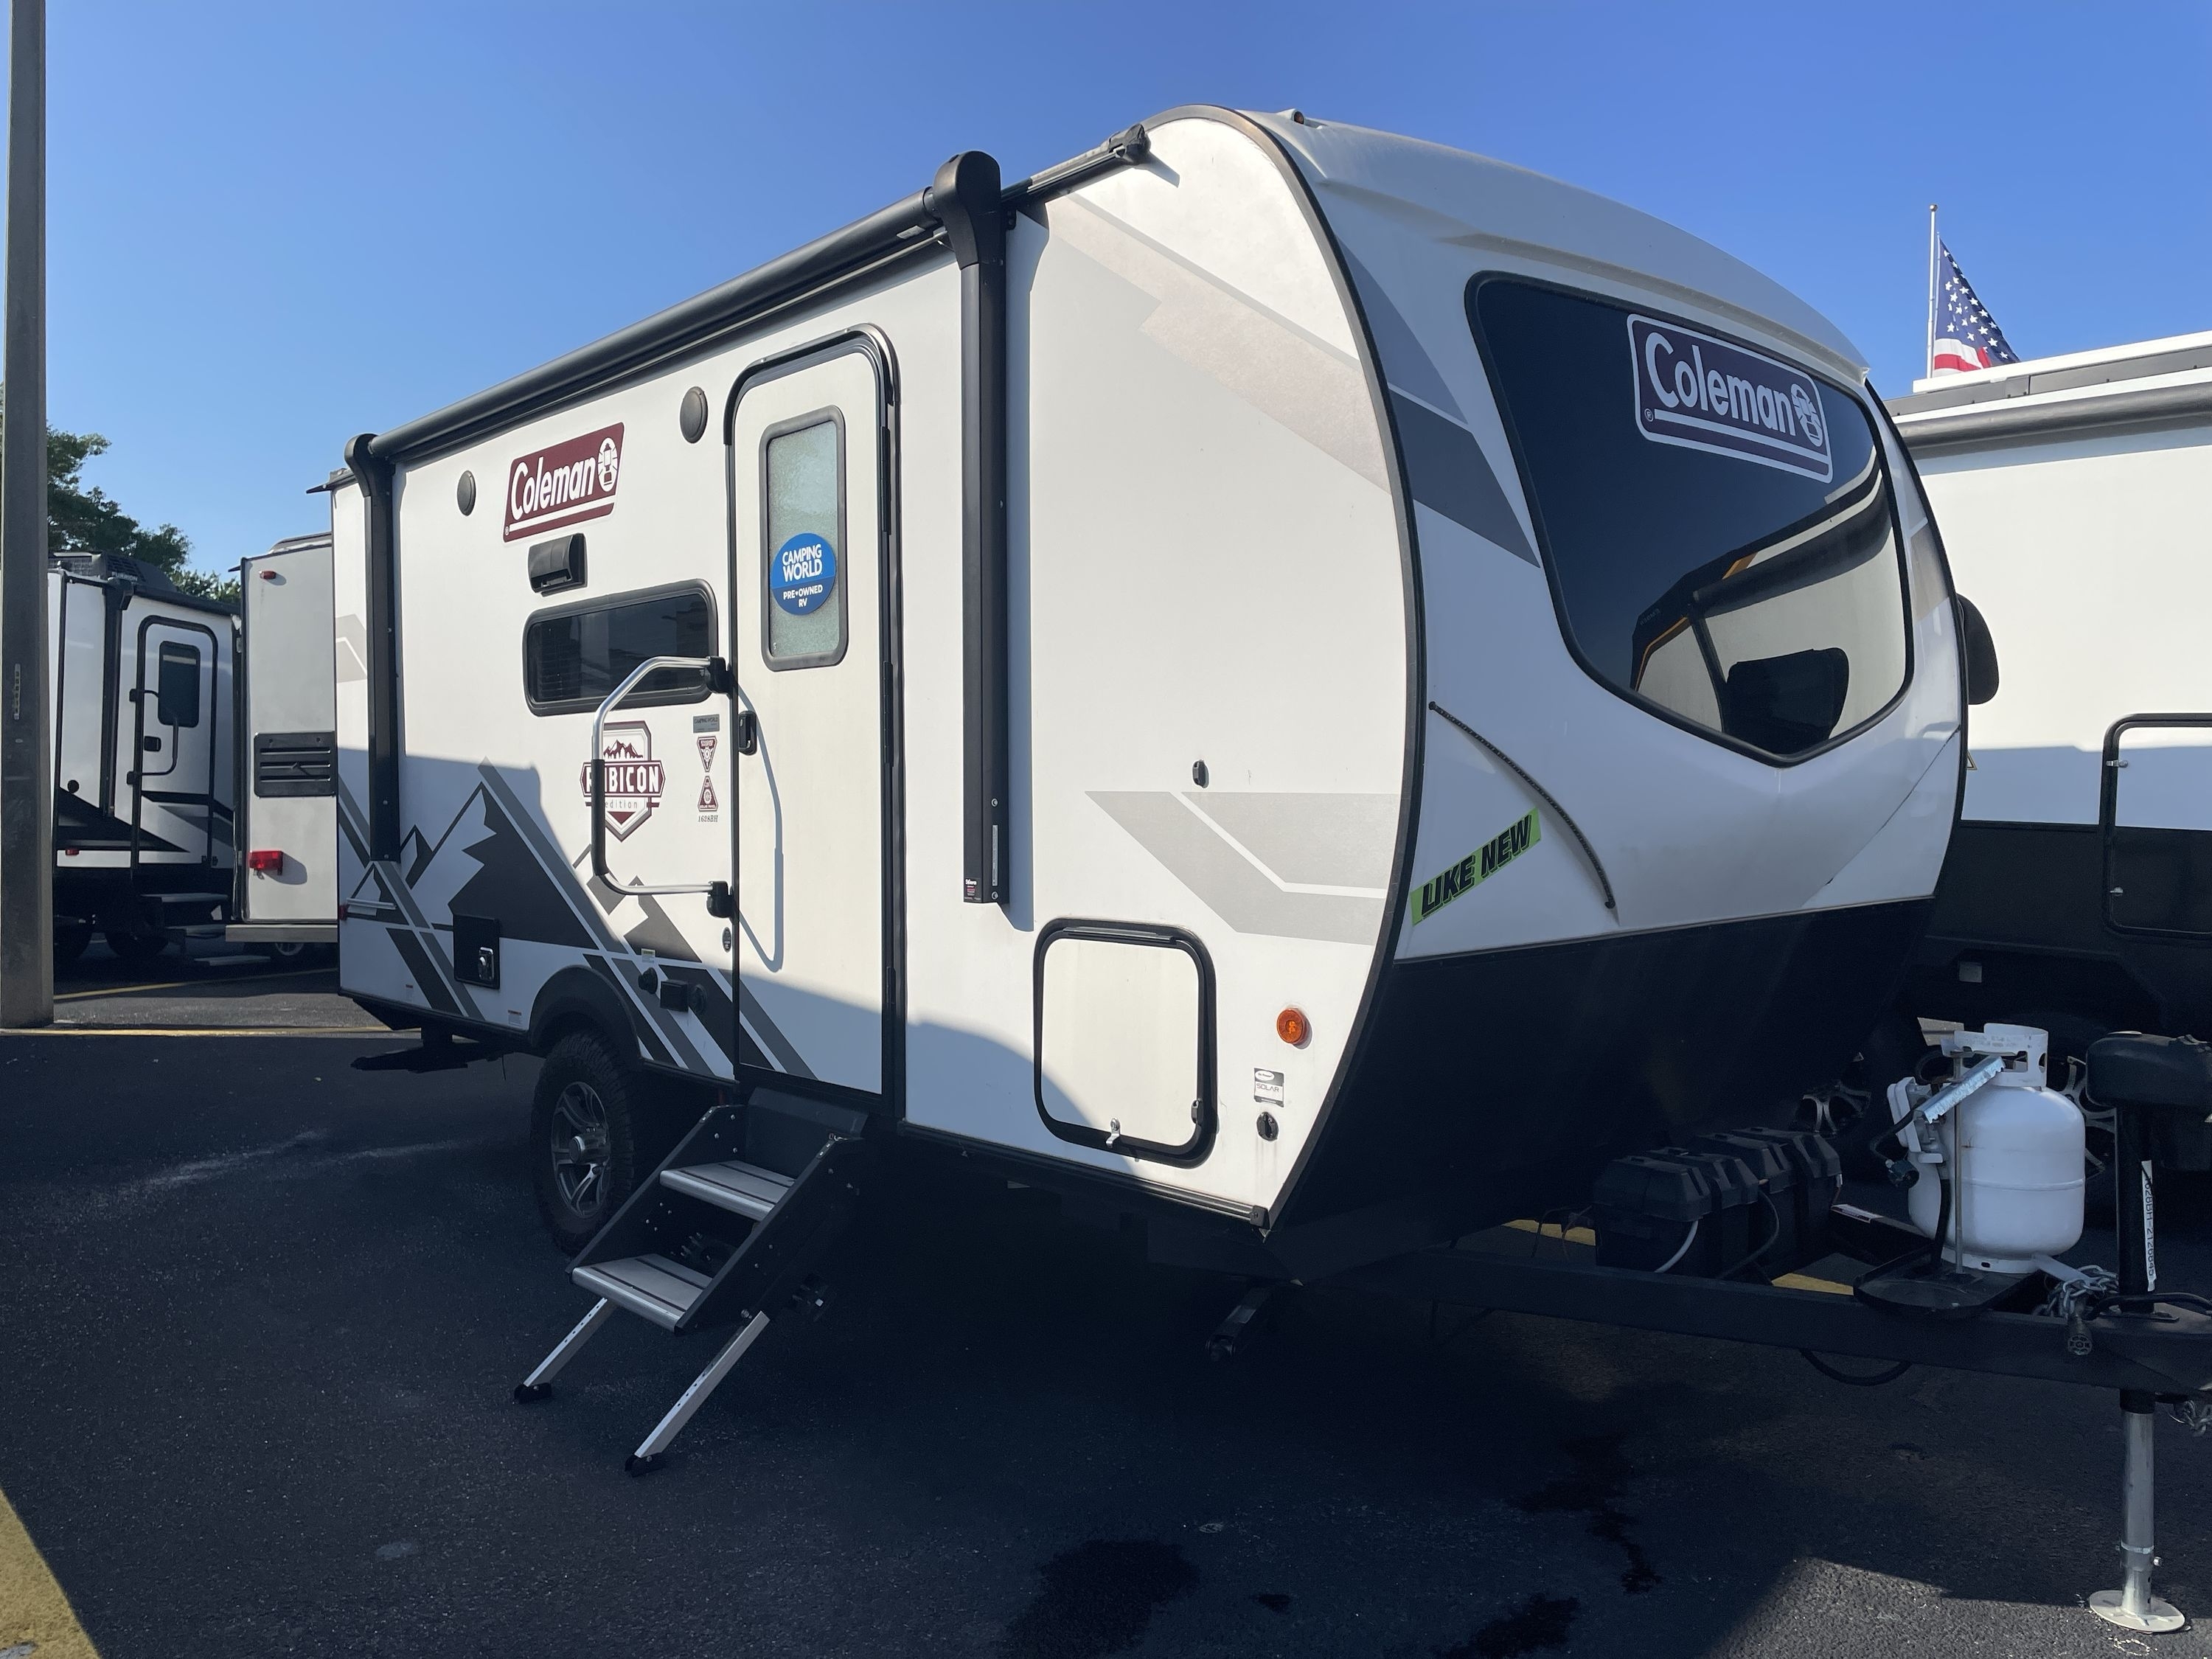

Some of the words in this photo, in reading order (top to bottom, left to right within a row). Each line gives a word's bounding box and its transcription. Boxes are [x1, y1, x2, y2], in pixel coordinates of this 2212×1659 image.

[1645, 332, 1796, 437] Coleman
[511, 456, 597, 521] Coleman
[782, 543, 822, 566] CAMPING
[782, 560, 823, 582] WORLD
[799, 597, 808, 608] RV
[605, 799, 638, 809] edition
[698, 815, 718, 823] 1628BH
[1422, 854, 1475, 919] LIKE
[1481, 814, 1532, 879] NEW
[1256, 1082, 1279, 1093] SOLAR
